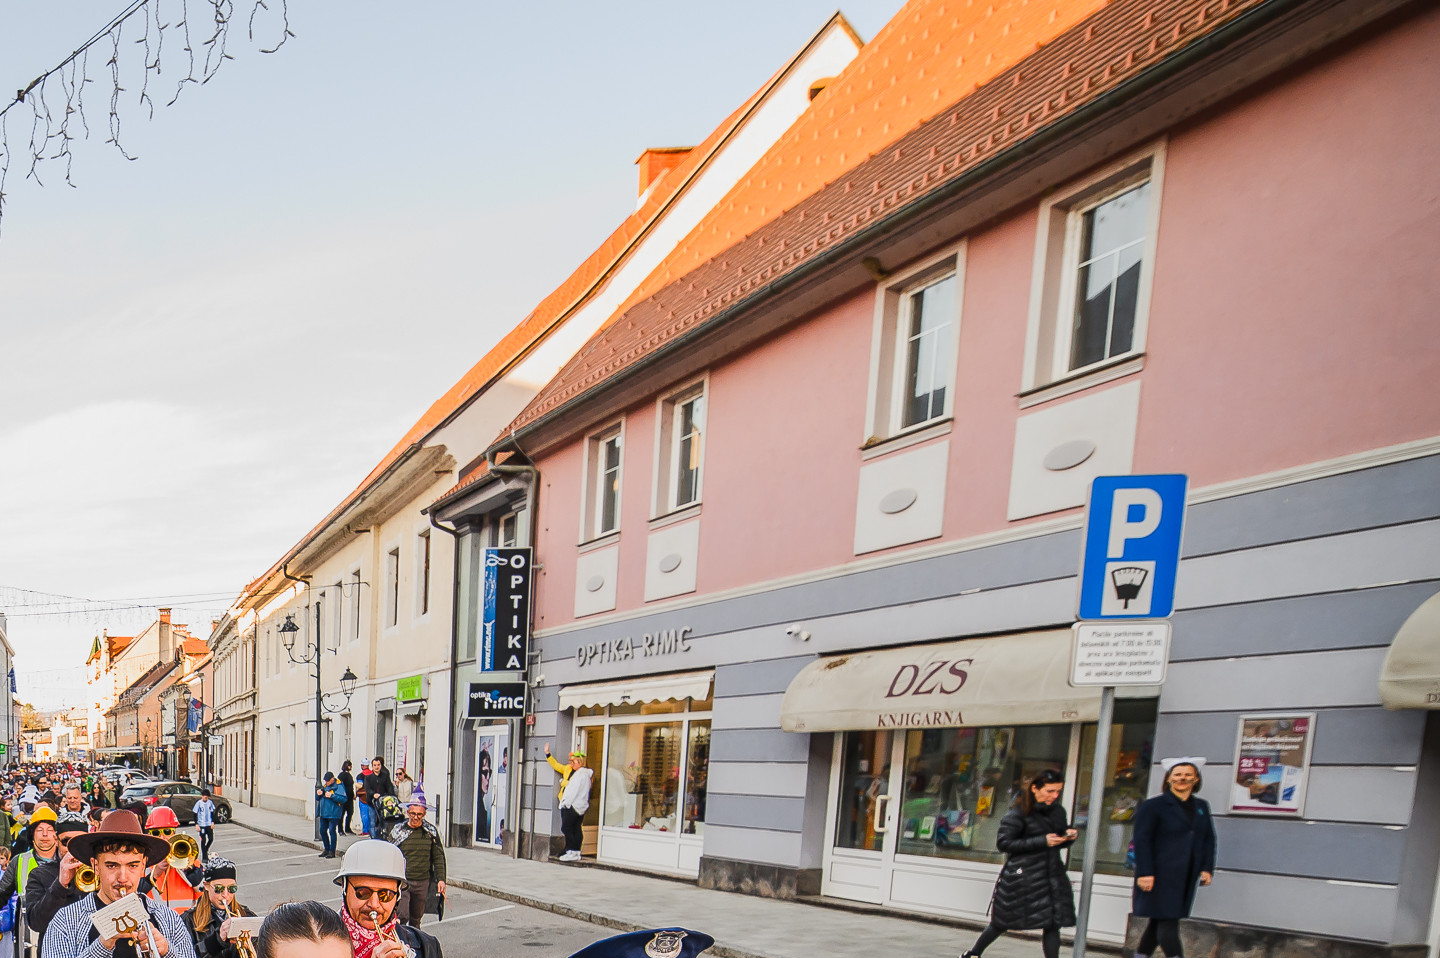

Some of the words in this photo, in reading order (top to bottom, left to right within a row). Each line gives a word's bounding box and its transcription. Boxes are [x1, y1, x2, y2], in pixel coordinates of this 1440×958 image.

[1106, 487, 1163, 559] P
[506, 554, 526, 669] OPTIKA
[576, 637, 634, 667] OPTIKA
[641, 625, 693, 657] RIMC
[470, 690, 491, 700] optika
[884, 658, 974, 699] DZS
[484, 696, 524, 710] rimc
[877, 711, 965, 728] KNJIGARNA
